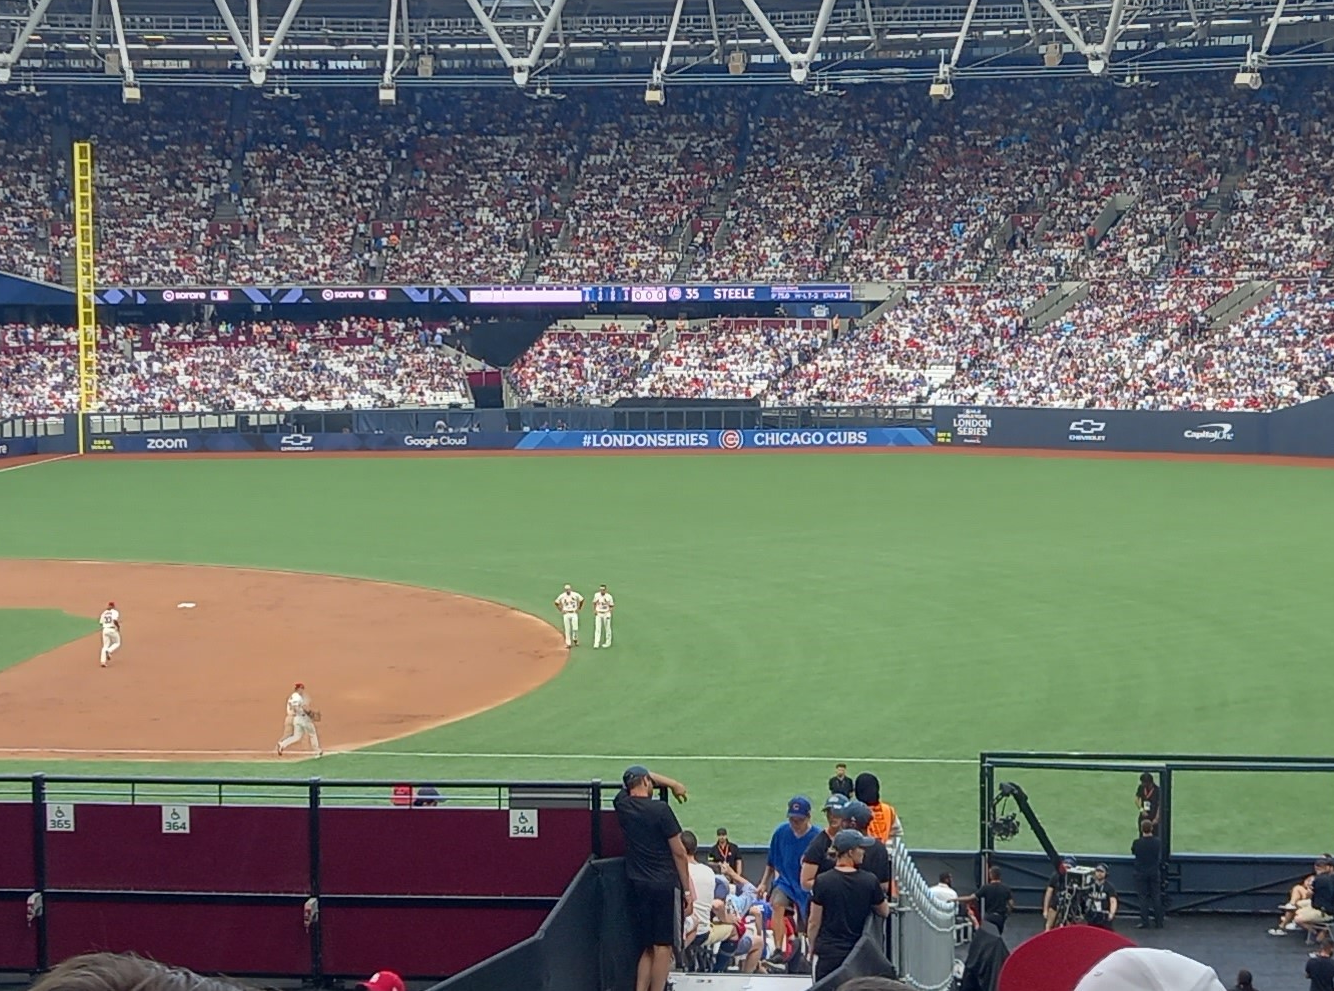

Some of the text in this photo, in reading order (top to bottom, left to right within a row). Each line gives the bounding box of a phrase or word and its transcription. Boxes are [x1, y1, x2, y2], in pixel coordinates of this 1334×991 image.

[175, 291, 207, 300] sorare
[334, 290, 365, 299] sorare
[685, 288, 756, 300] 35 STEELE
[953, 418, 992, 429] LONDON
[957, 427, 988, 436] SERIES
[146, 438, 188, 449] zoom
[404, 435, 467, 448] Google Cloud
[582, 433, 709, 447] #LONDONSERIES
[754, 432, 823, 446] CHICAGO
[826, 431, 867, 444] CUBS
[49, 819, 71, 829] 365
[164, 821, 187, 831] 364
[512, 825, 534, 835] 344
